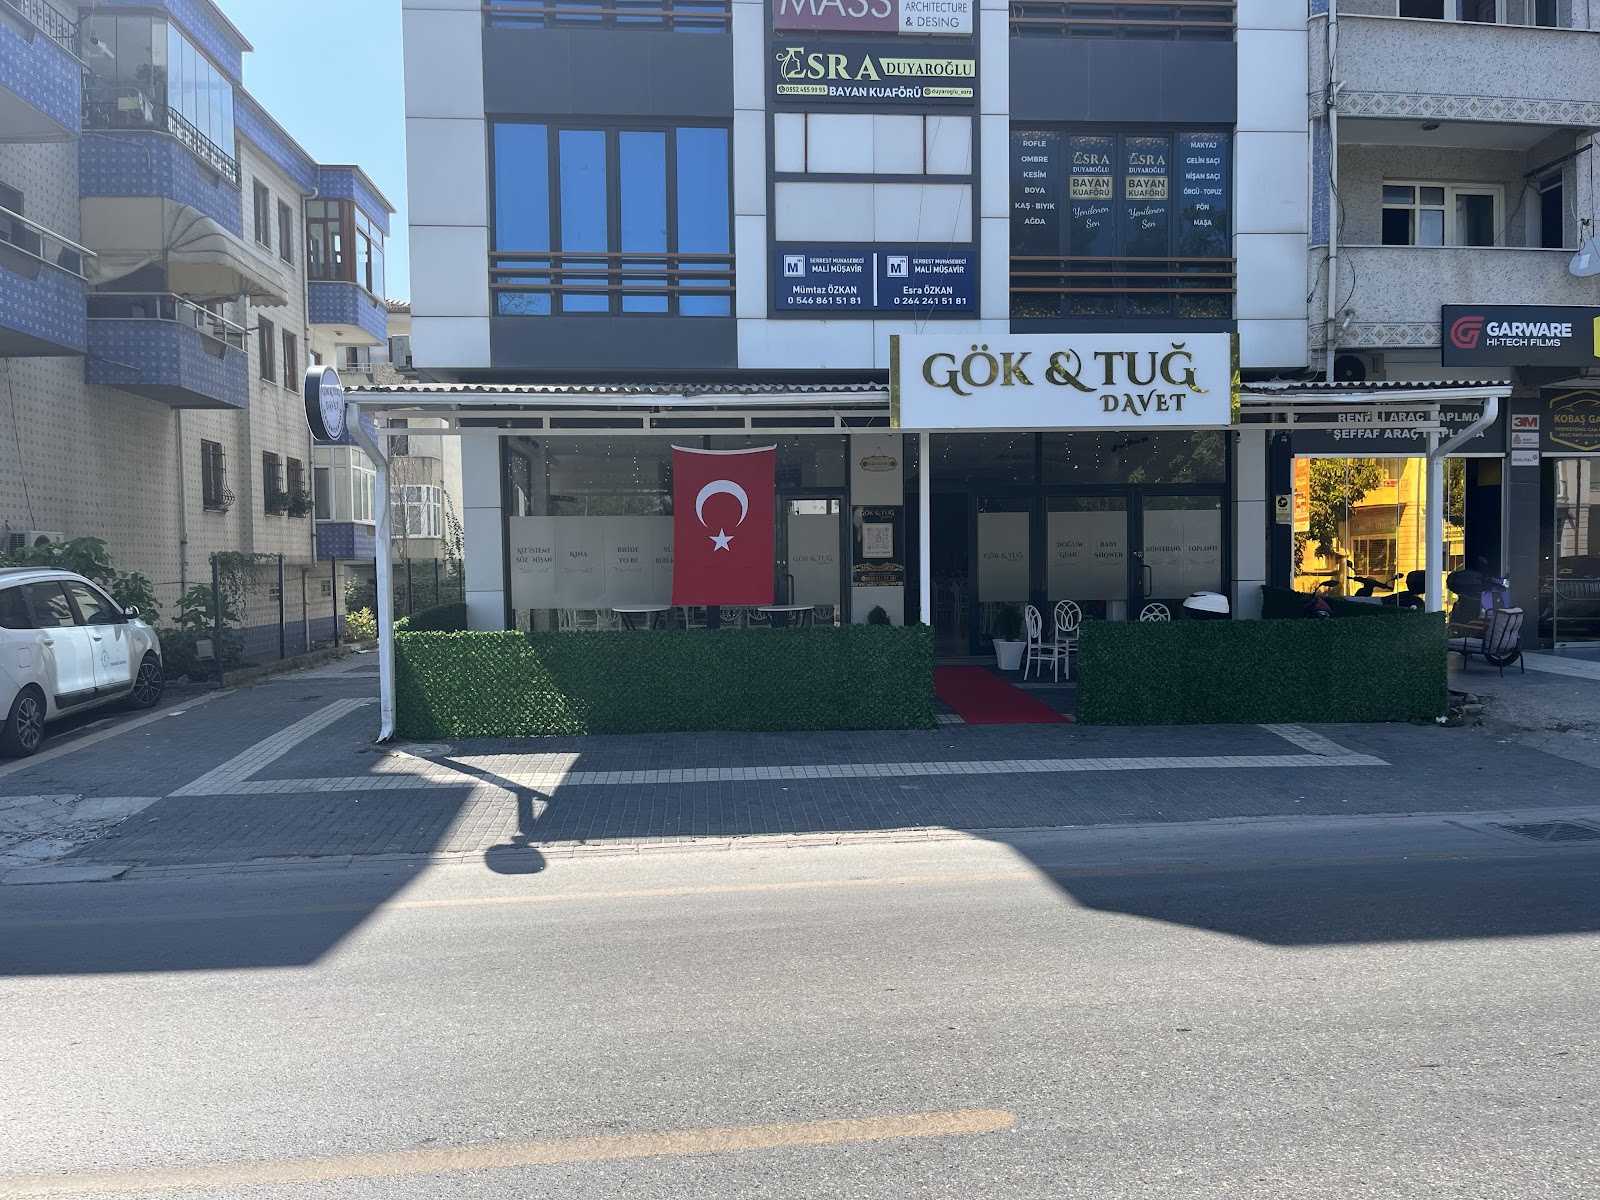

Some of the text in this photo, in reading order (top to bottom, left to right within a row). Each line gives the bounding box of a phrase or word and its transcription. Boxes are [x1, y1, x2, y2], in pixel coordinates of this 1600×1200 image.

[904, 2, 968, 13] ARCHITECTURE
[905, 16, 960, 28] & DESING
[886, 60, 972, 76] DUYAROĞLU
[829, 86, 921, 98] BAYAN KUAFÖRÜ
[1023, 170, 1046, 178] KESİM
[1186, 172, 1220, 181] NİŞAN SAÇI
[1073, 179, 1109, 187] BAYAN
[1129, 180, 1165, 188] BAYAN
[1128, 189, 1165, 197] KUAFÖRÜ
[1073, 205, 1109, 218] Yenilenen
[1128, 206, 1165, 219] Yenilenen
[1086, 219, 1100, 229] Sen
[1142, 219, 1156, 229] Sen
[812, 264, 862, 274] MALİ MÜŞAVİR
[915, 265, 964, 274] MALİ MÜŞAVİR
[792, 284, 857, 294] Mümtaz ÖZKAN
[903, 284, 953, 294] Esra ÖZKAN
[1486, 322, 1572, 337] GARWARE
[1486, 338, 1561, 347] HI-TECH FILMS
[922, 342, 1210, 396] GÖK & TUĞ
[1100, 389, 1186, 416] DAVET
[1436, 412, 1481, 422] APLMA
[1554, 414, 1585, 425] KOBAŞ
[1513, 417, 1537, 428] 3M
[1334, 429, 1380, 440] ŞEFFAF
[1384, 429, 1418, 440] ARAÇ
